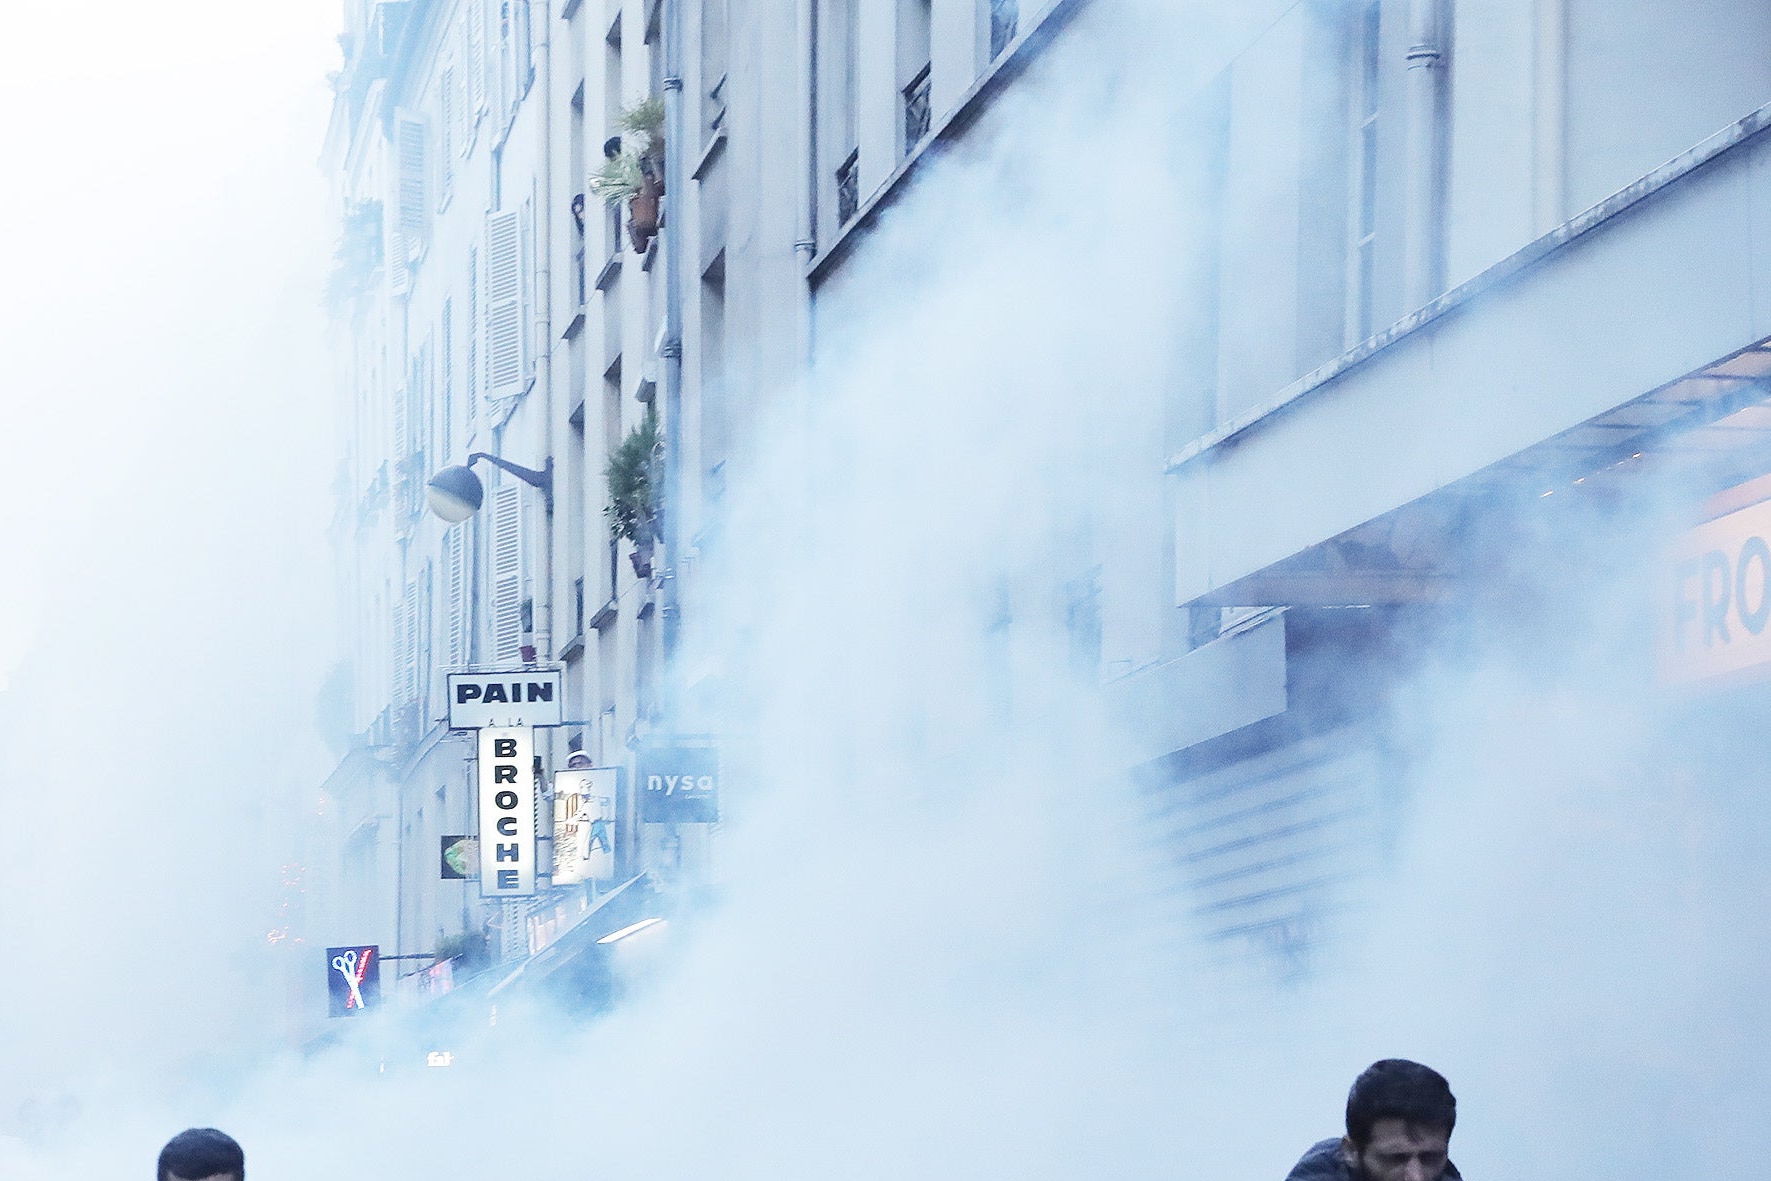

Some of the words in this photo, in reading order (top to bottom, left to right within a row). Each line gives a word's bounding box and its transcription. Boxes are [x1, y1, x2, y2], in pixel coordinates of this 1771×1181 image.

[456, 682, 553, 704] PAIN
[647, 775, 713, 796] nysa
[494, 738, 519, 889] BROCHE
